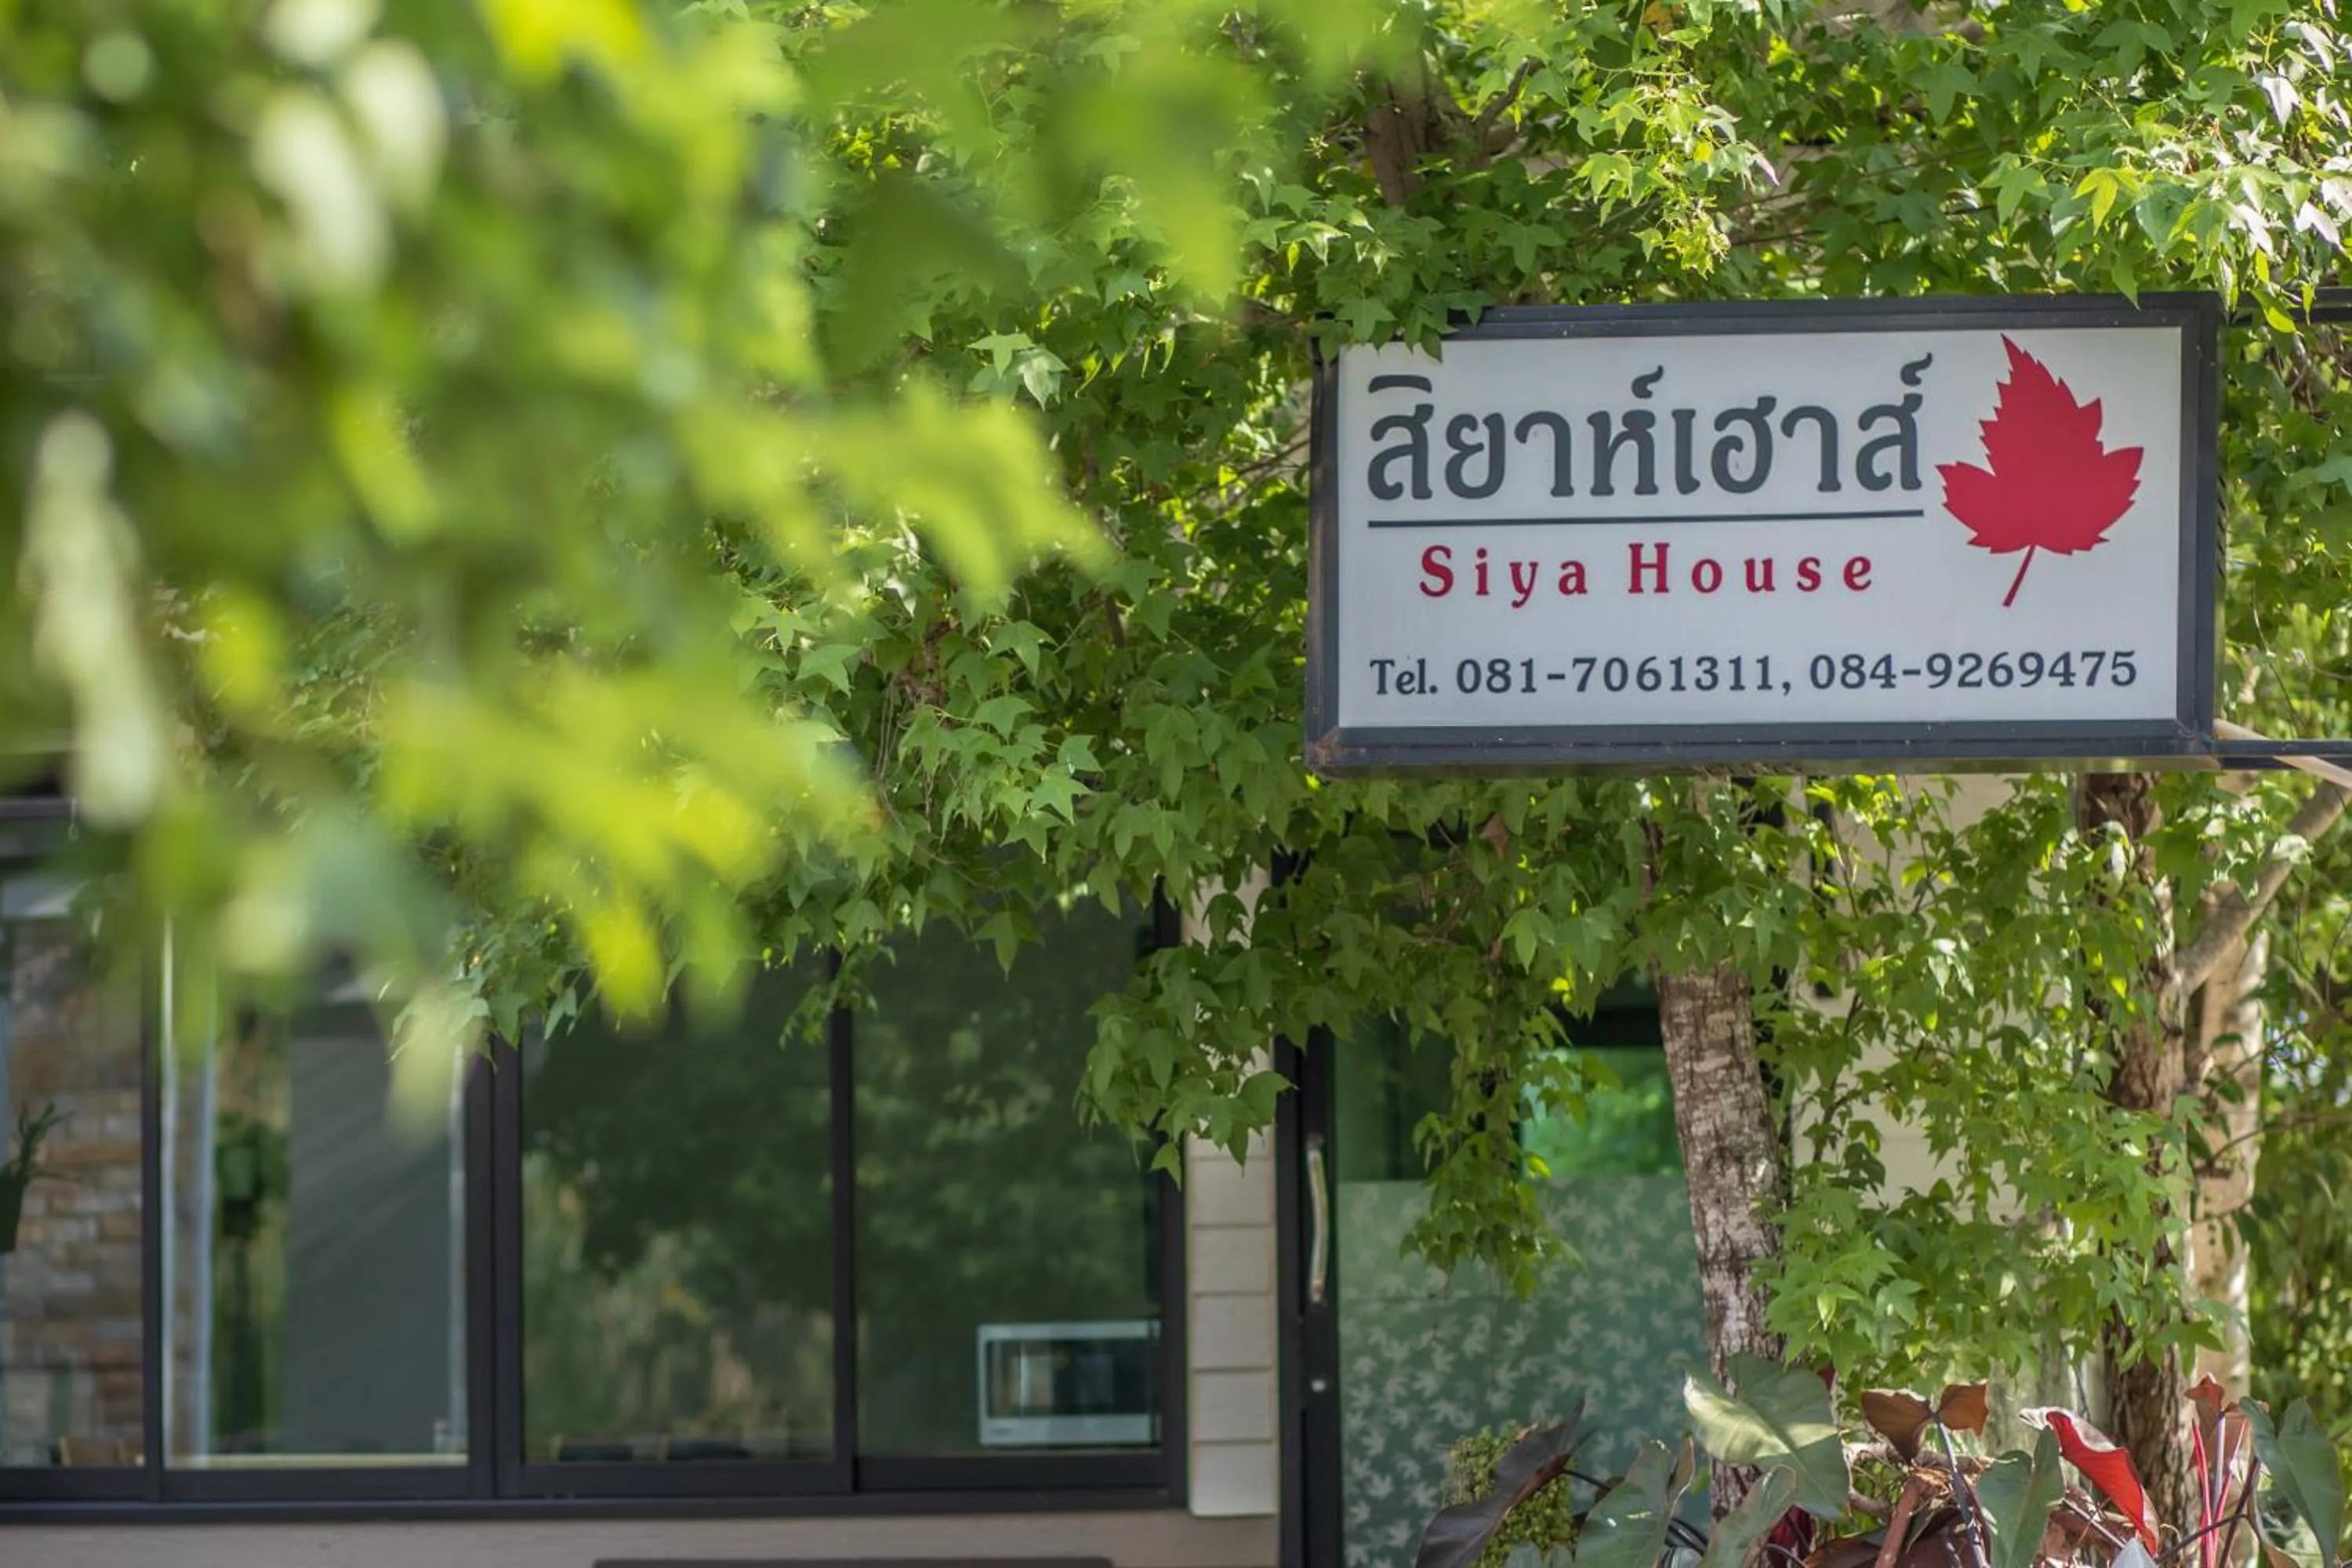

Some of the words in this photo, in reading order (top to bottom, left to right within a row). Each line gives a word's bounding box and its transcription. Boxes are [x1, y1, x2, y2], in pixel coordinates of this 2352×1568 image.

[1367, 351, 1933, 501] สิยาห์เฮาส์
[1419, 544, 1588, 609] Siya
[1628, 542, 1874, 594] House
[1369, 657, 1439, 696] Tel.
[1456, 655, 1792, 696] 081-7061311,
[1809, 650, 2138, 691] 084-9269475
